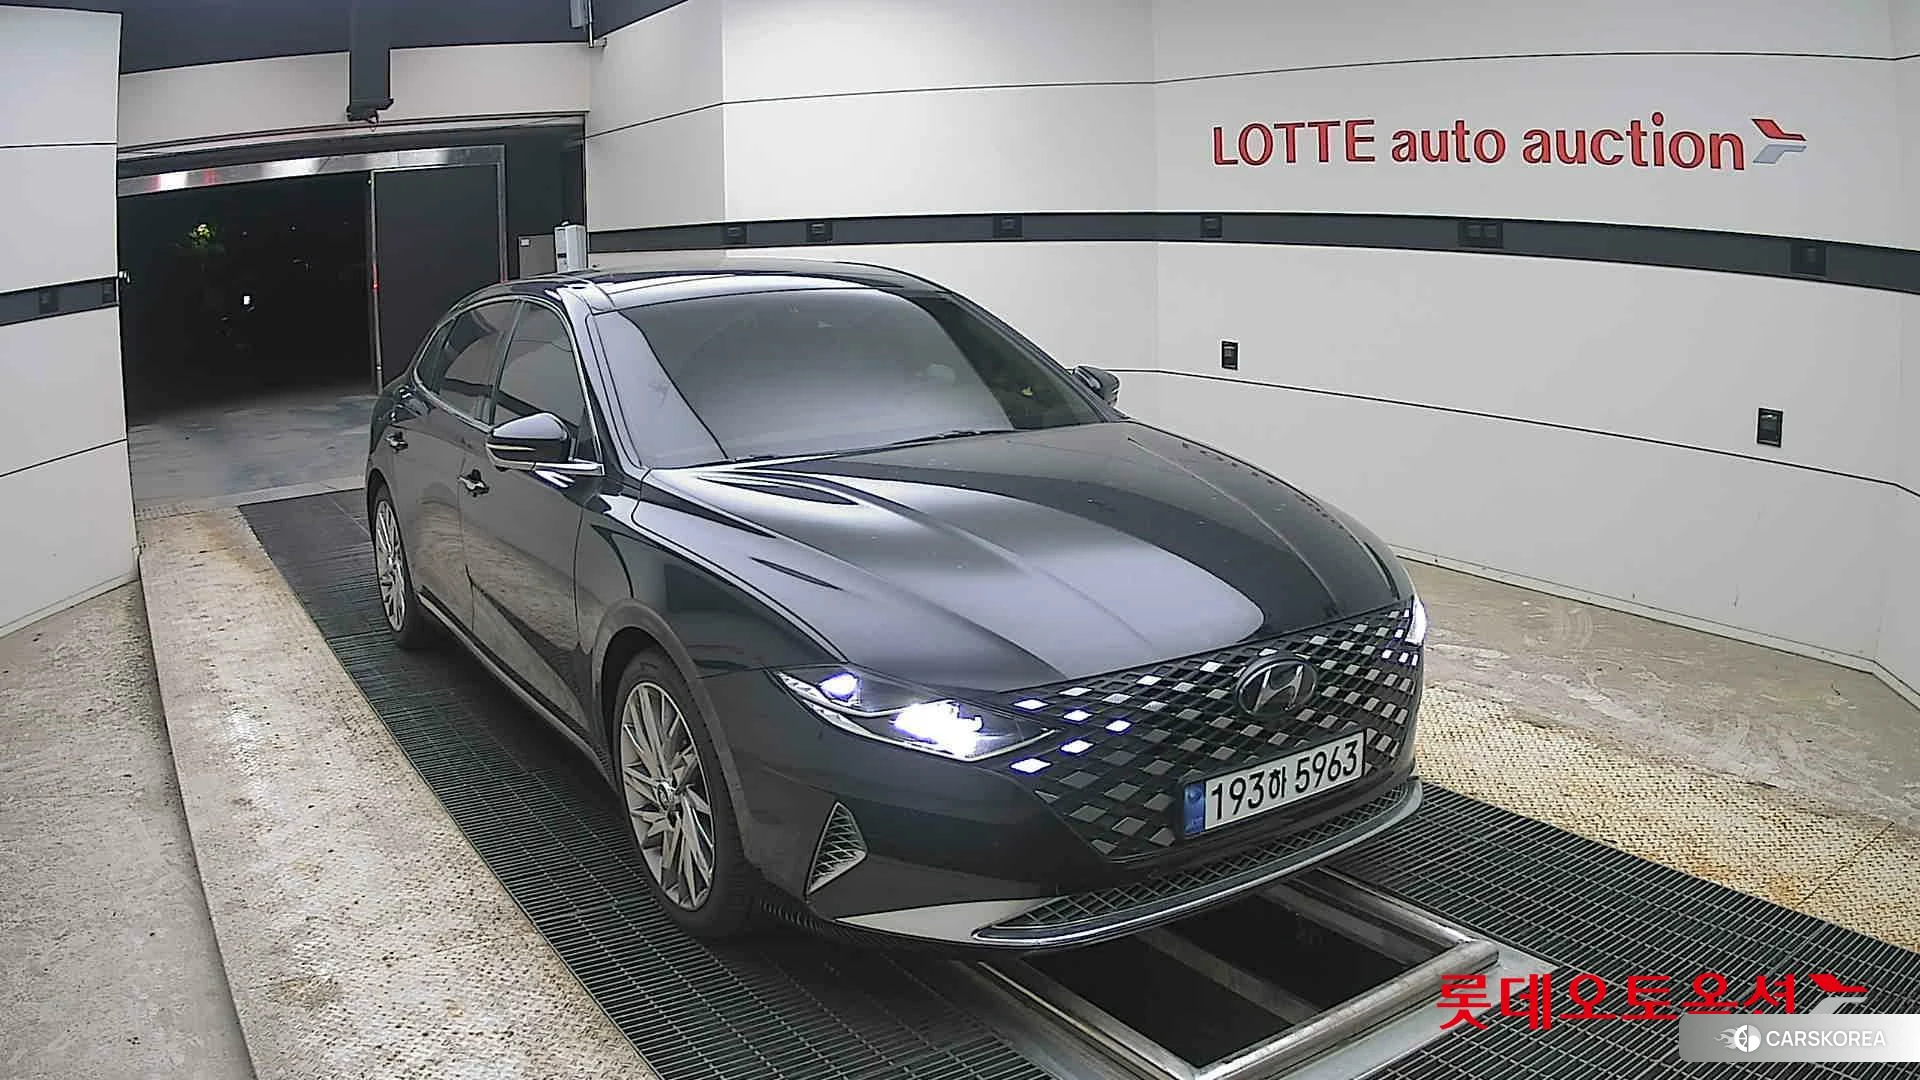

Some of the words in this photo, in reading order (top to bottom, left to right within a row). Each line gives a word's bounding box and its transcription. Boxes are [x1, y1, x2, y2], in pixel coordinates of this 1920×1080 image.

[1212, 119, 1376, 166] LOTTE
[1391, 119, 1507, 164] auto
[1521, 111, 1745, 170] auction
[1211, 765, 1287, 820] 193하
[1294, 739, 1359, 794] 5963
